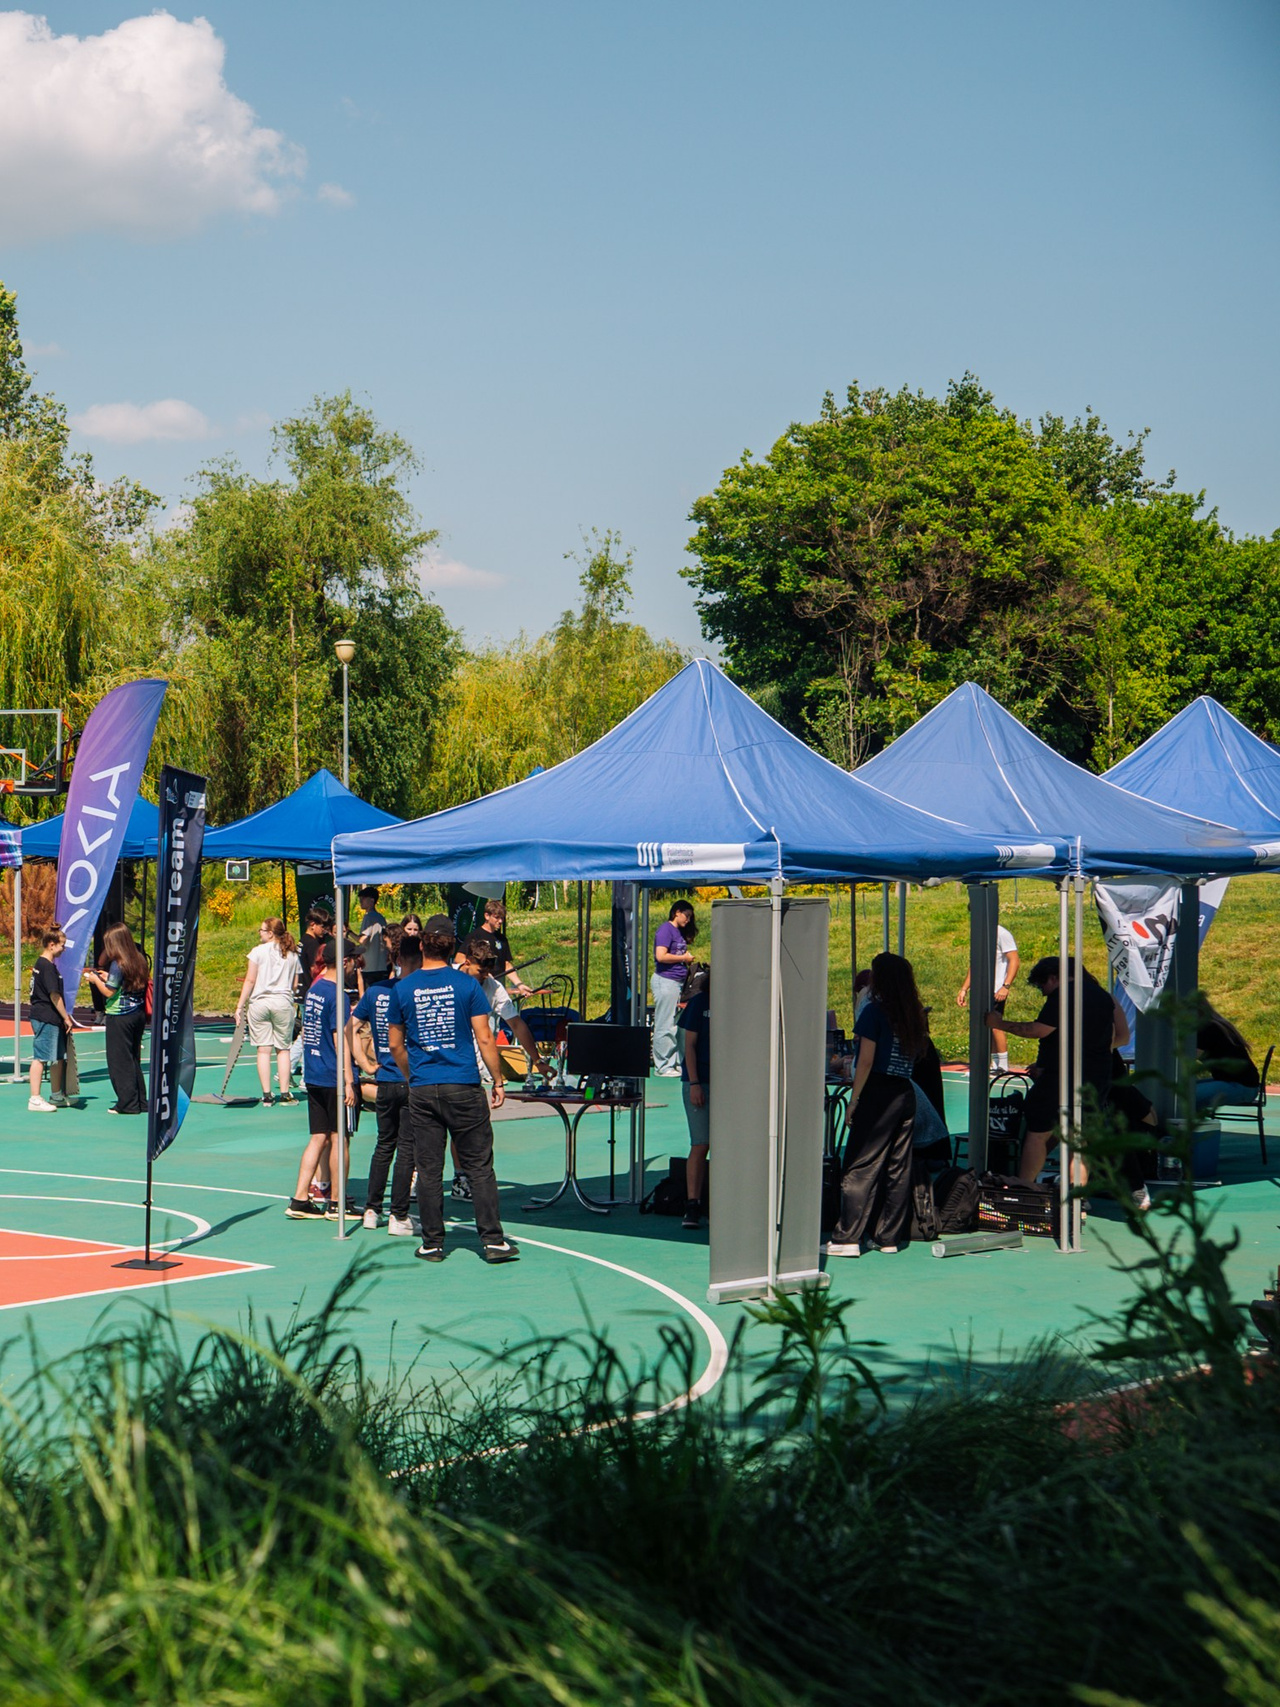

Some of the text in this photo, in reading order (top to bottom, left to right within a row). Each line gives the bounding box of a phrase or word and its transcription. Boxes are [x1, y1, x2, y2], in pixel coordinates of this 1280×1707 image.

[61, 761, 131, 949] NOKIA
[167, 817, 185, 913] Team
[170, 970, 183, 1034] Formula
